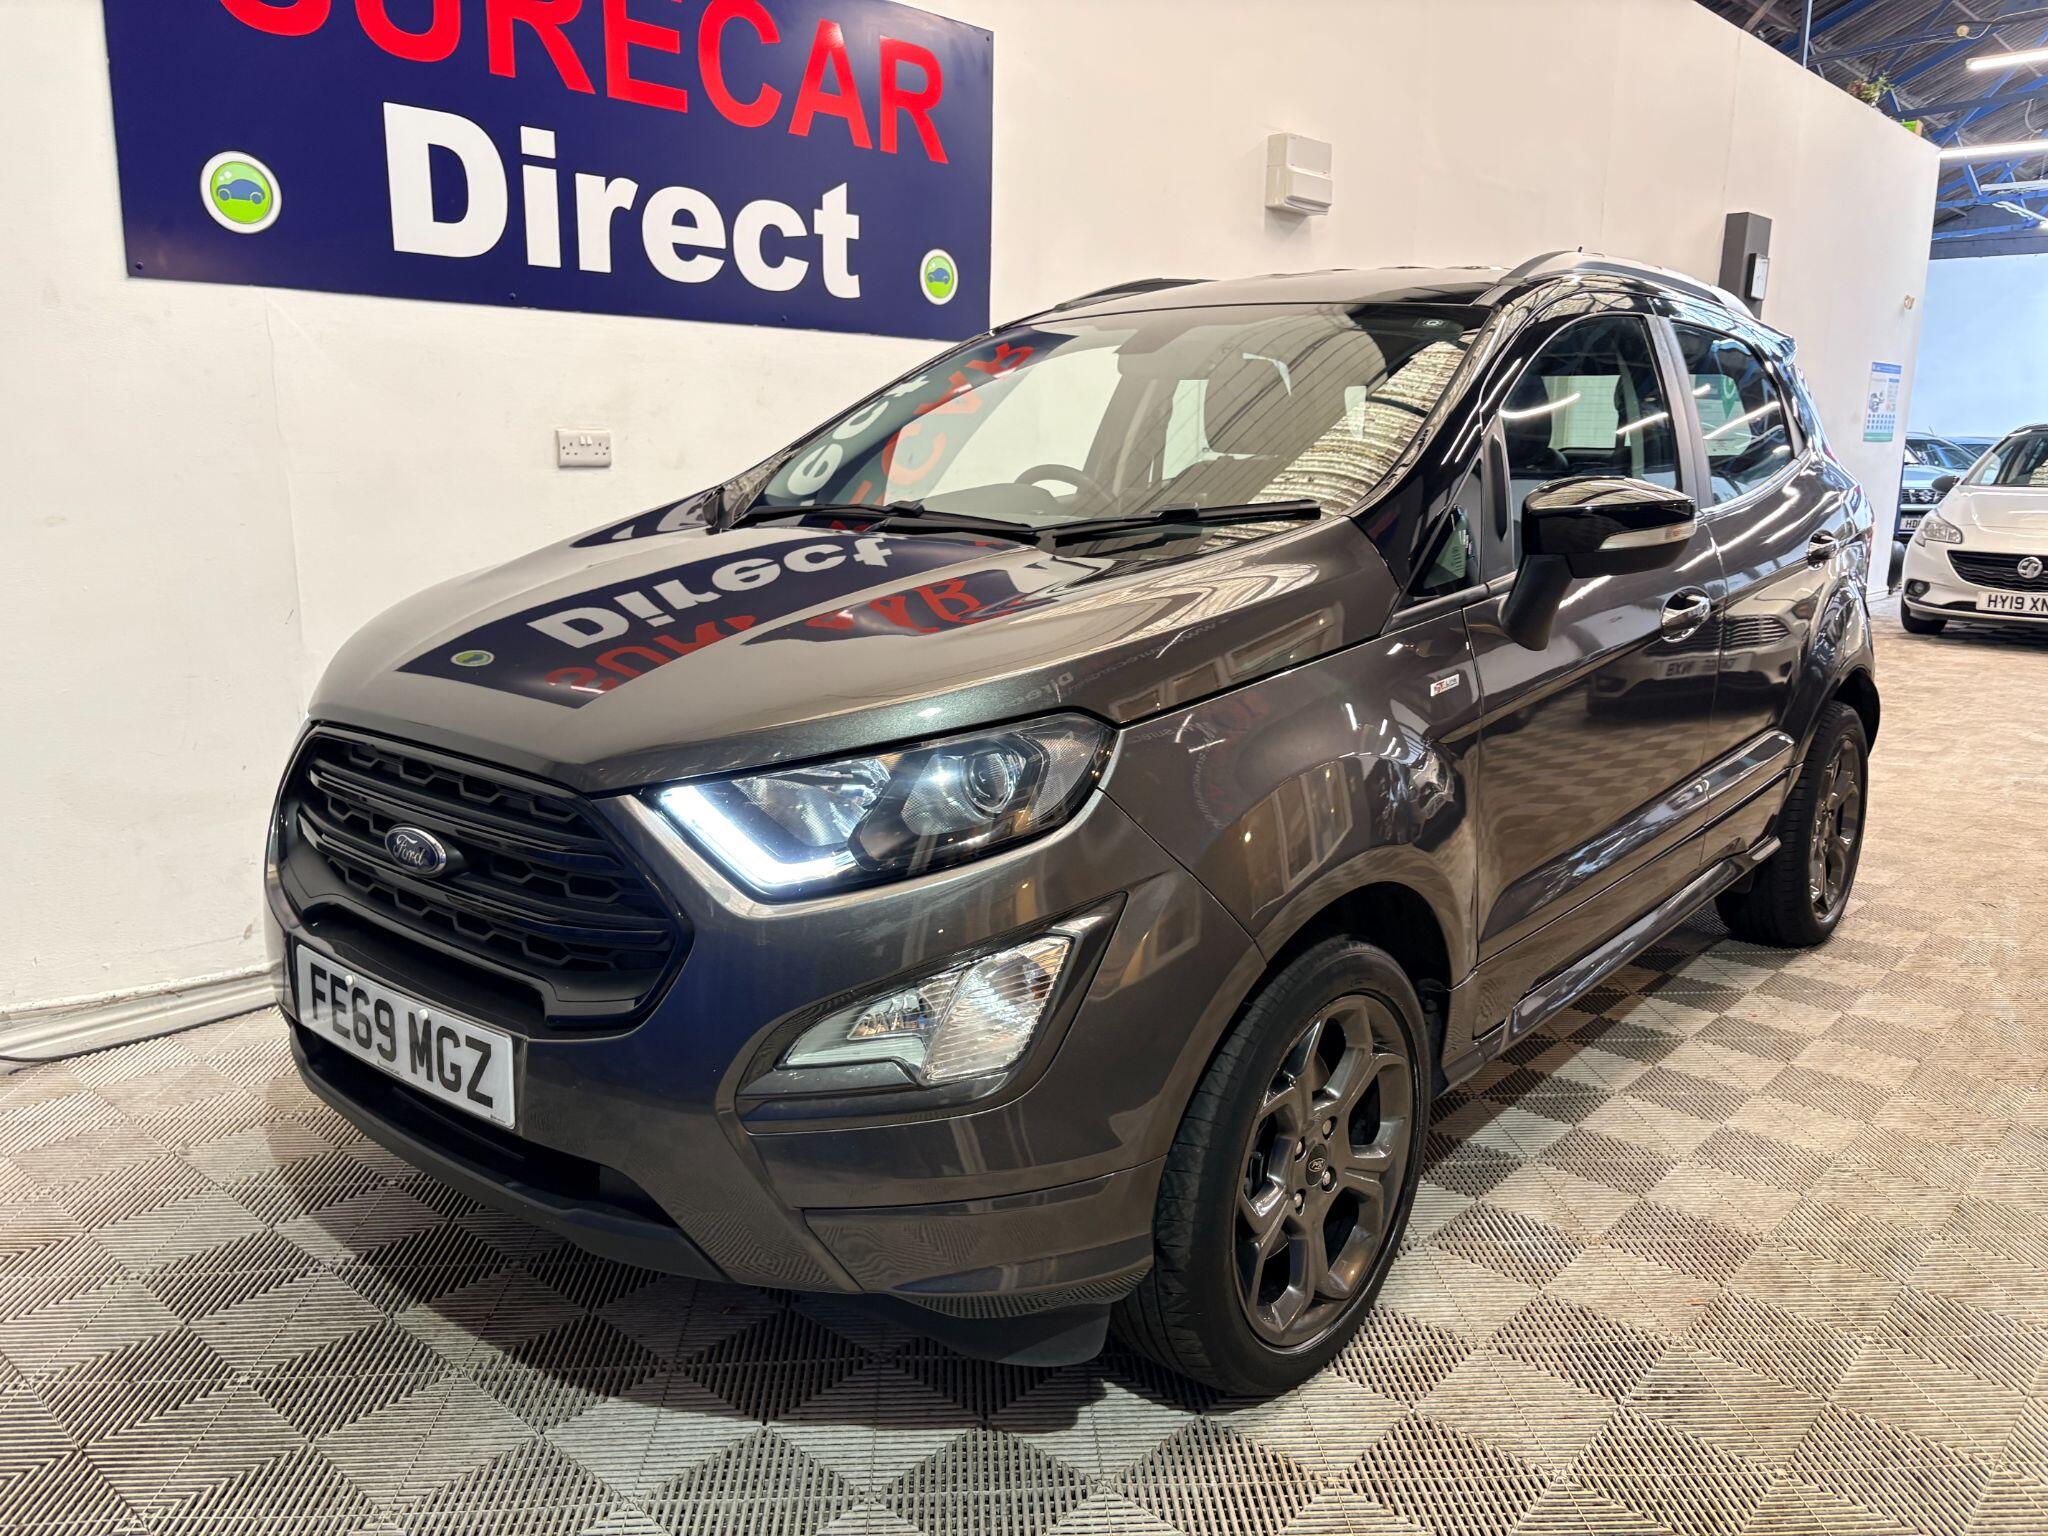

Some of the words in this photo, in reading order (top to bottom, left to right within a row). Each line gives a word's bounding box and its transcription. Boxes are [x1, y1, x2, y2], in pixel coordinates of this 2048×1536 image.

[382, 101, 861, 299] Direct
[1987, 594, 2025, 610] HY19
[393, 834, 425, 866] Ford
[310, 963, 397, 1062] FE69
[408, 1011, 494, 1109] MGZ
